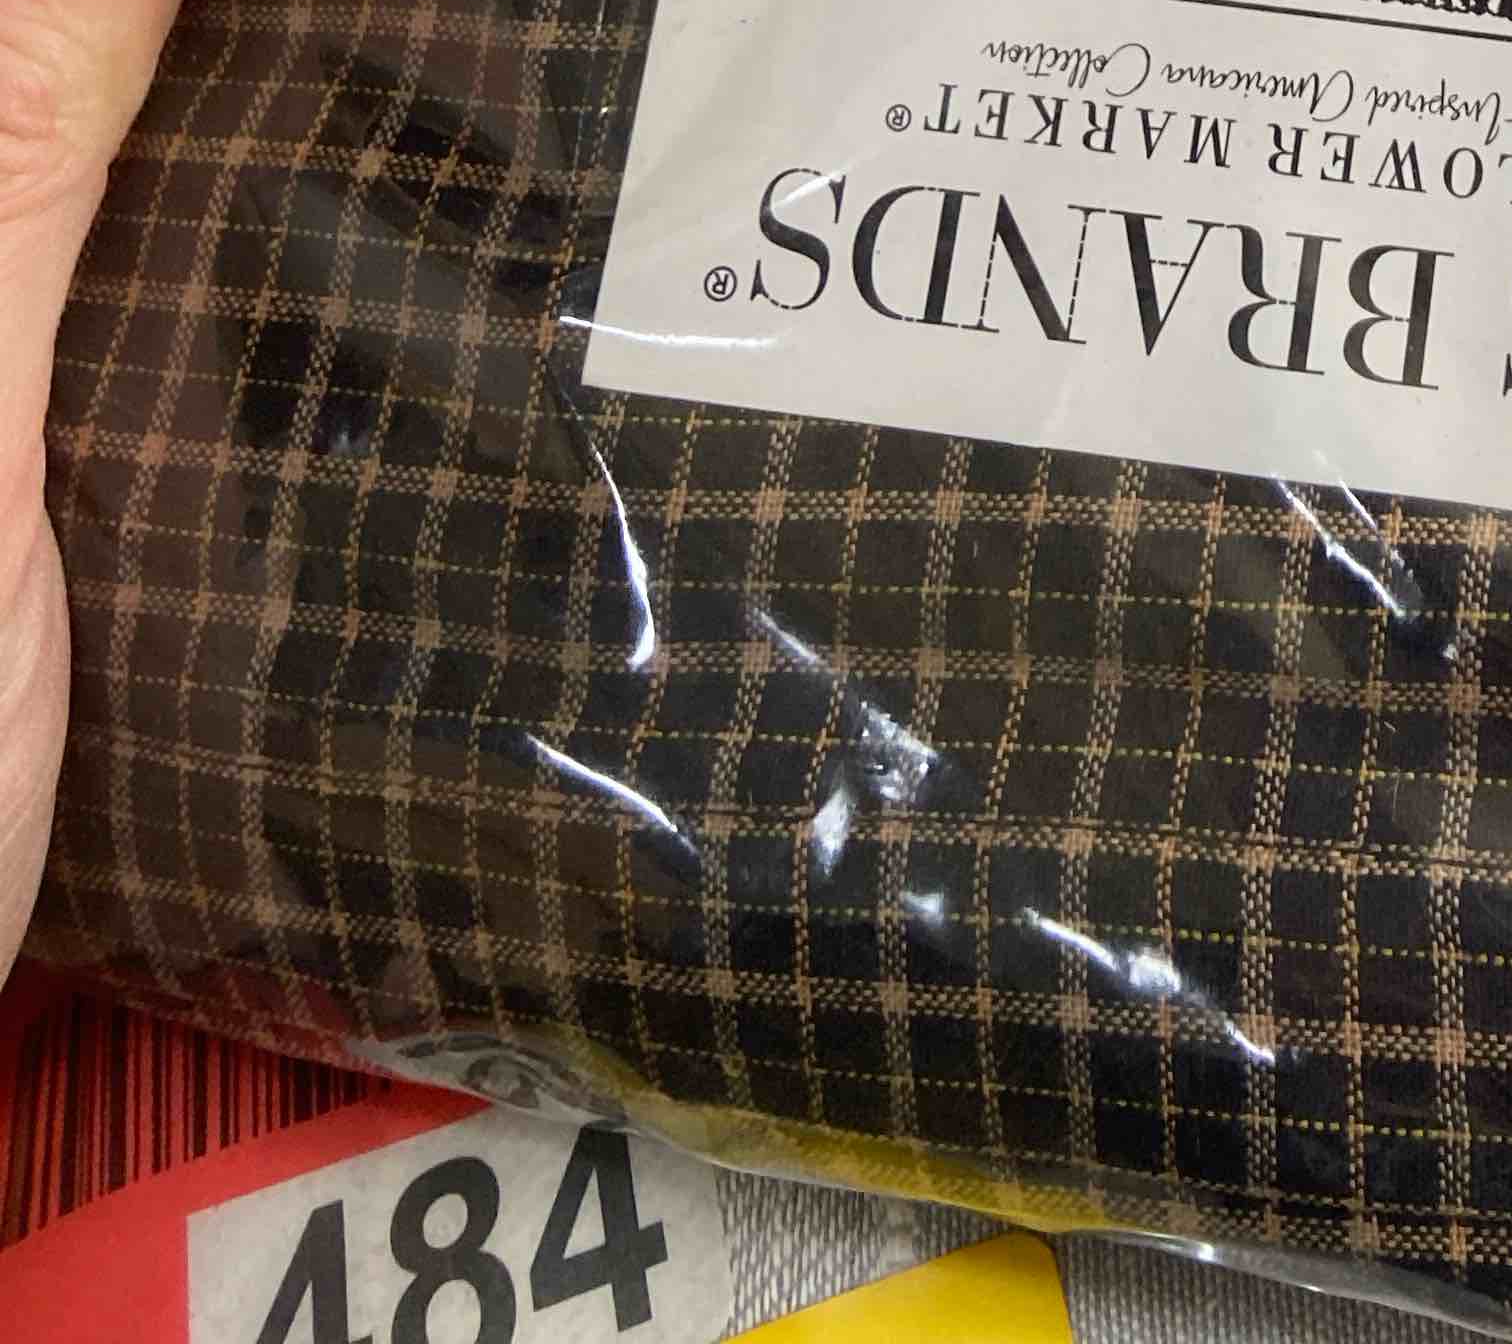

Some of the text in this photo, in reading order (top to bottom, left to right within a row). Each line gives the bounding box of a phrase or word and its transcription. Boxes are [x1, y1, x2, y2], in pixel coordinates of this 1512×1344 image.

[981, 40, 1151, 97] Collection
[1160, 62, 1354, 122] Americana
[251, 1120, 668, 1344] 484
